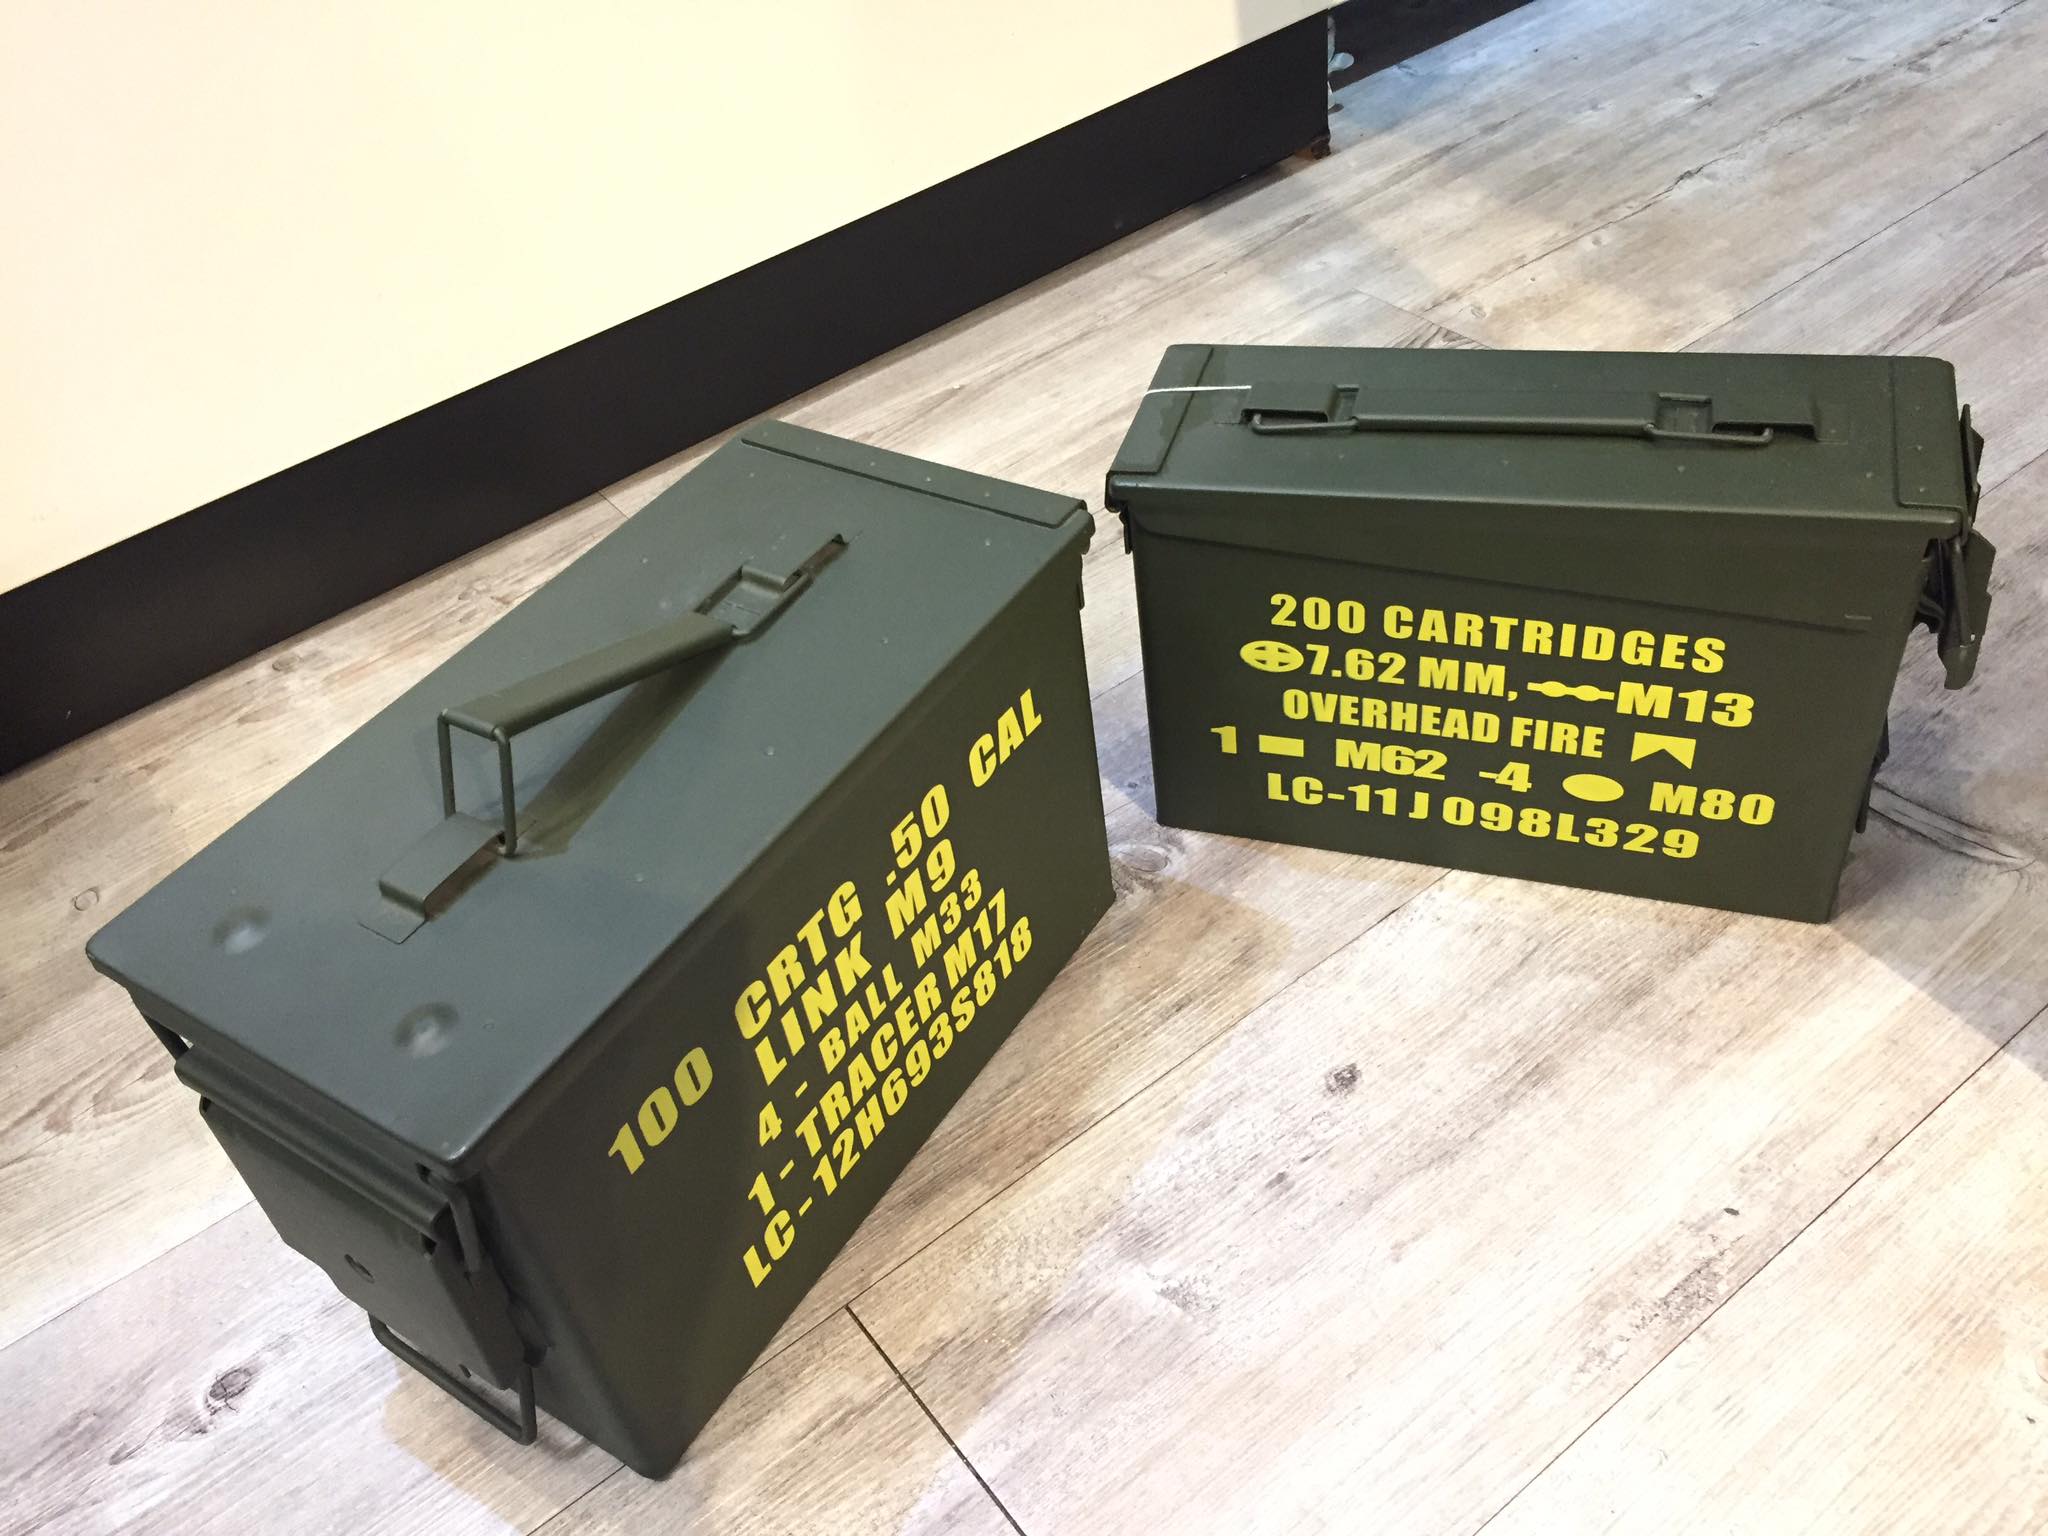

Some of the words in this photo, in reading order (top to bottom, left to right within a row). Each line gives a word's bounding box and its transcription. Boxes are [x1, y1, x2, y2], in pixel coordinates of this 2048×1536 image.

[1270, 593, 1366, 635] 200
[1384, 604, 1726, 674] CARTRIDGES
[1282, 688, 1501, 744] OVERHEAD
[1511, 716, 1606, 759] FIRE
[1307, 643, 1407, 685] 7.62
[1419, 655, 1519, 702] MM,
[1616, 681, 1755, 728] M13
[1211, 725, 1238, 754] 1
[1335, 738, 1448, 781] M62
[1649, 781, 1776, 826] M80
[607, 1049, 714, 1175] 100
[735, 881, 863, 1040] CRTG
[886, 783, 950, 887] .50
[968, 687, 1043, 788] CAL
[754, 931, 873, 1086] LINK
[885, 838, 956, 939] M9
[943, 888, 1007, 989] M17
[758, 1102, 783, 1146] 4
[818, 964, 904, 1073] BALL
[911, 868, 983, 967] M33
